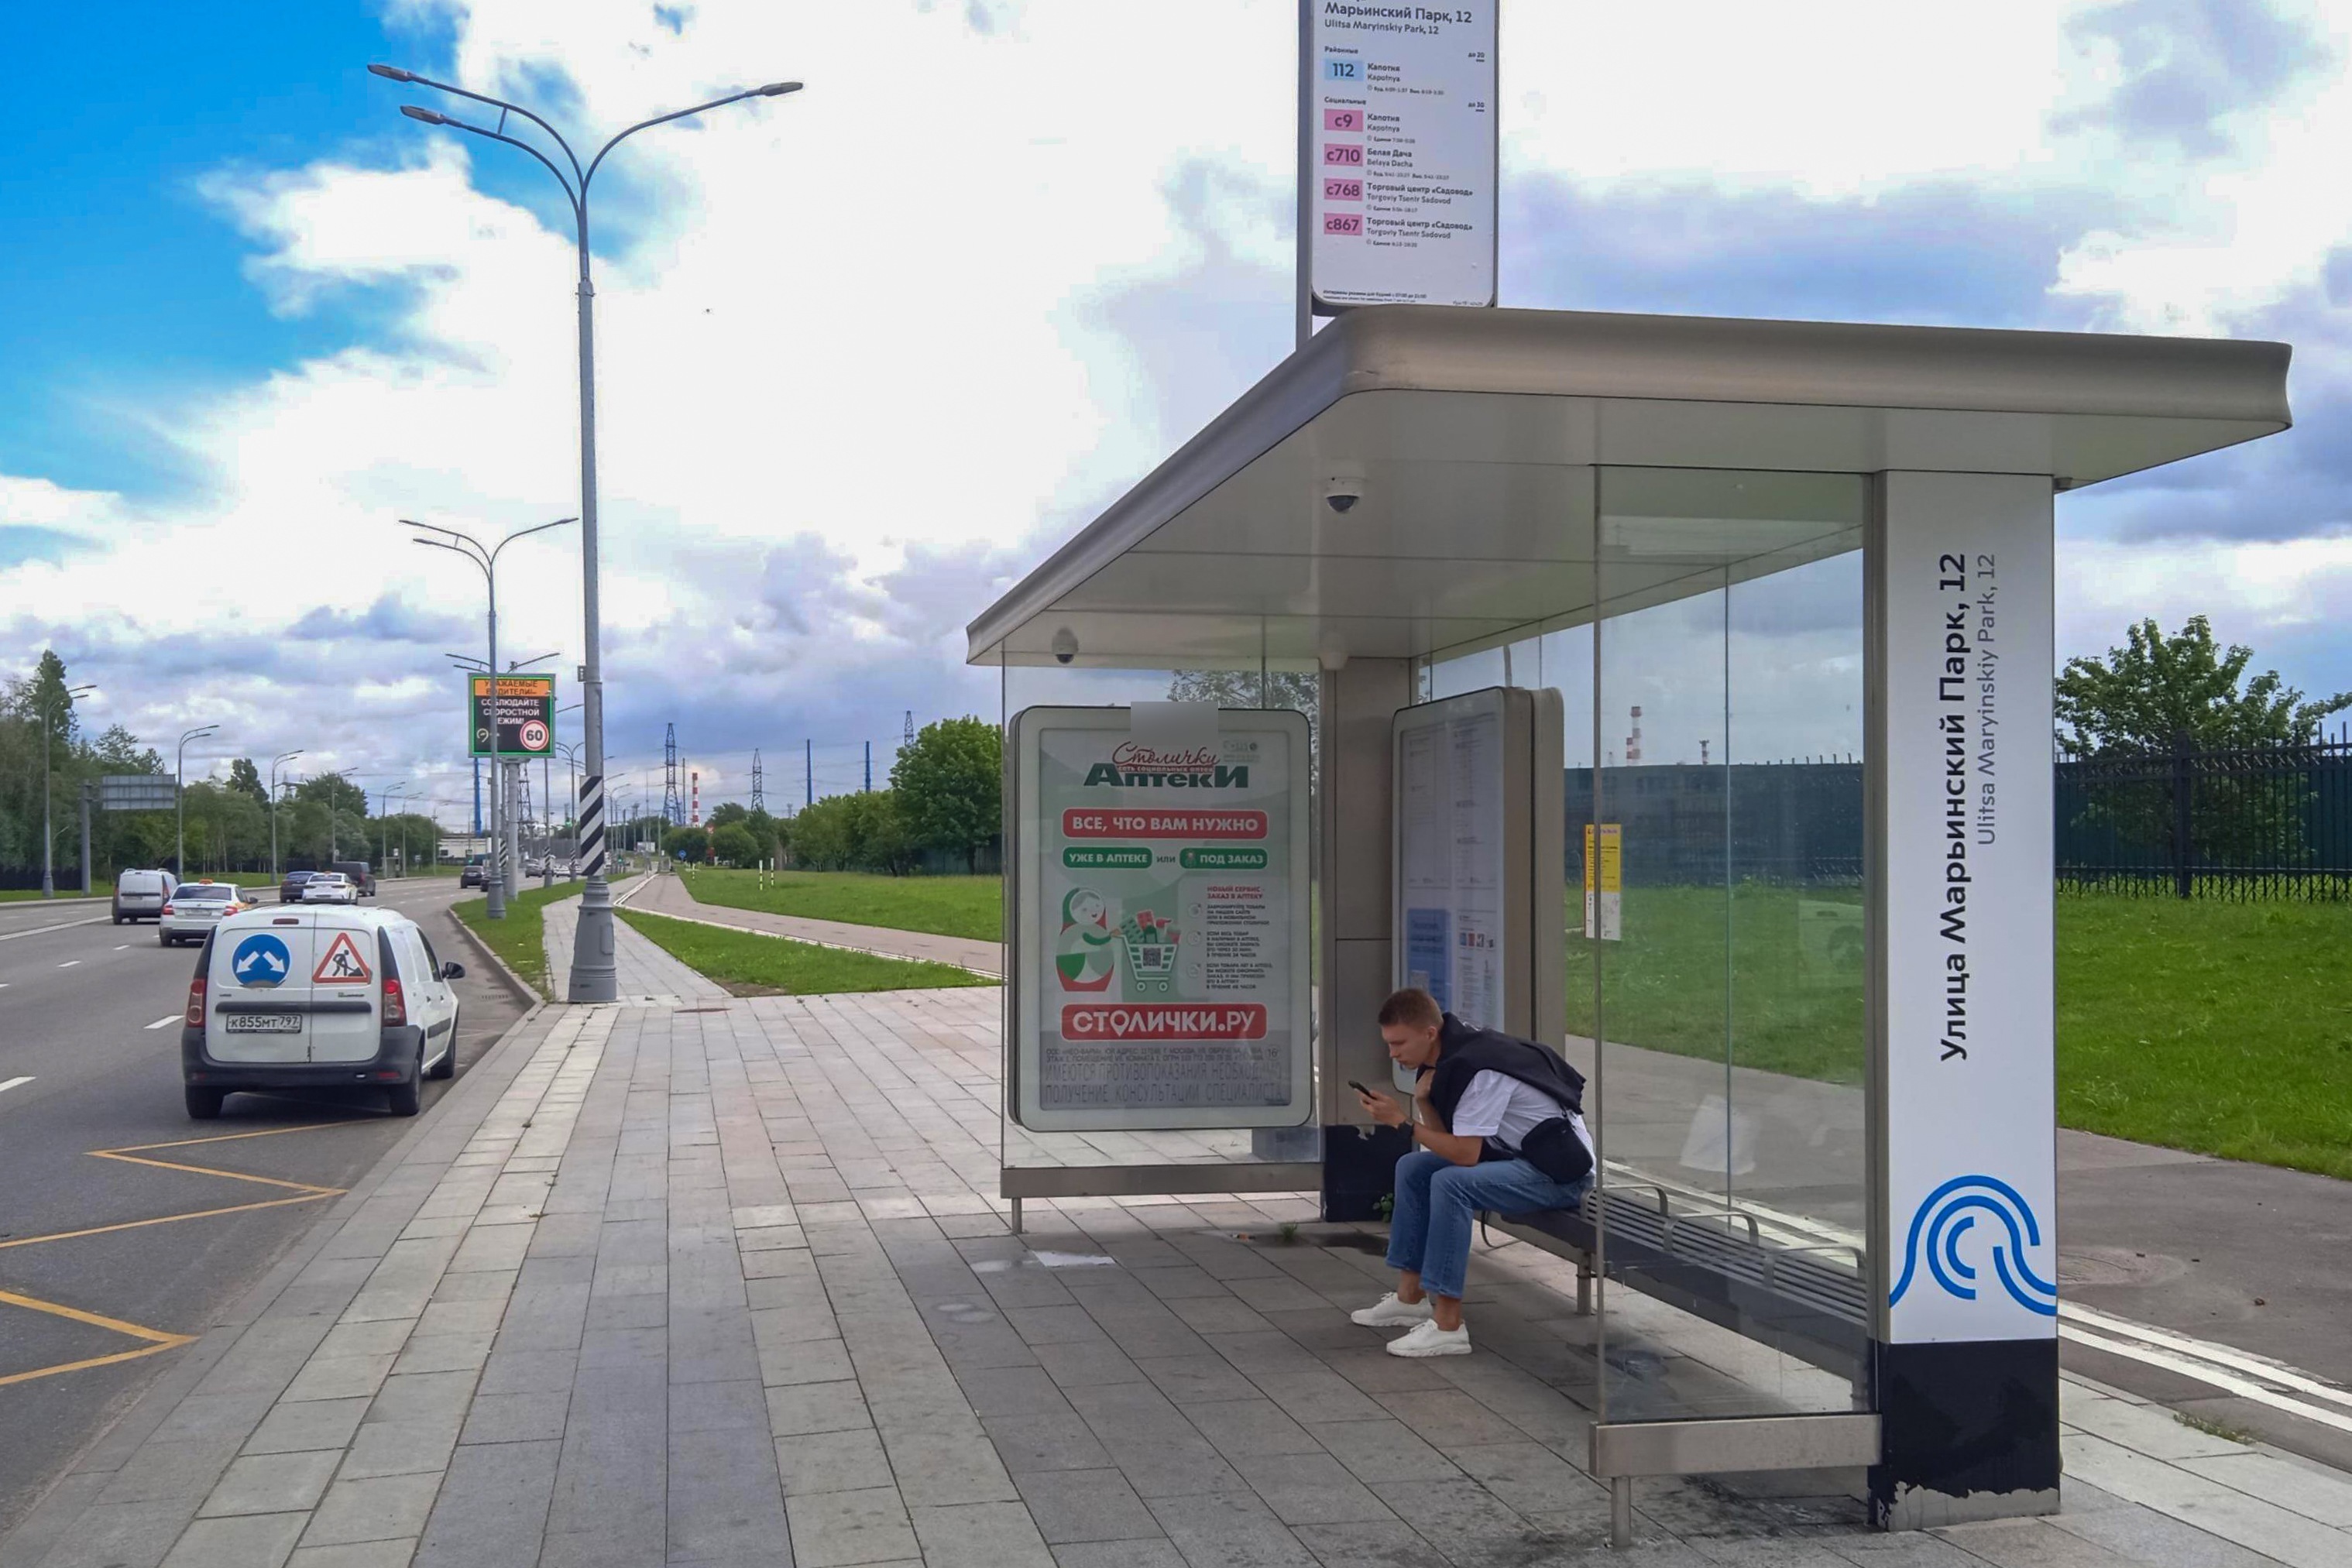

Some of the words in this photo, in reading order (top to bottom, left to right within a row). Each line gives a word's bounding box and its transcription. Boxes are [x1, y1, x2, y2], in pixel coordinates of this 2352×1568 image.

[1324, 2, 1412, 19] Марьинский
[1415, 8, 1453, 24] Парк,
[1455, 11, 1472, 23] 12
[1324, 19, 1351, 29] Ulitsa
[1353, 21, 1403, 33] Maryinskiy
[1404, 24, 1427, 35] Park,
[1428, 26, 1439, 35] 12
[1333, 63, 1355, 77] 112
[1367, 63, 1400, 72] Капотня
[1367, 74, 1400, 83] Kapotnya
[1367, 113, 1400, 122] Капотня
[1367, 124, 1400, 132] Kapotnya
[1367, 148, 1391, 156] Белая
[1392, 149, 1413, 158] Дача
[1367, 159, 1390, 167] Belaya
[1367, 183, 1406, 192] Торговый
[1406, 186, 1430, 195] центр
[1431, 186, 1473, 196] «Садовод»
[1421, 196, 1451, 204] Sadovod
[1367, 218, 1405, 227] Торговый
[1406, 220, 1430, 228] центр
[1431, 221, 1473, 231] «Садовод»
[1421, 231, 1451, 239] Sadovod
[1939, 554, 1966, 592] 12
[1977, 554, 1995, 578] 12
[1976, 586, 1998, 642] Park,
[1939, 603, 1971, 701] Парк,
[1976, 649, 1999, 777] Maryinskiy
[526, 729, 544, 742] 60
[1111, 741, 1221, 765] Столички
[1976, 783, 1996, 845] Ulitsa
[1072, 816, 1107, 832] ВСЕ,
[1112, 817, 1146, 831] ЧТО
[1150, 817, 1188, 831] ВАМ
[1193, 818, 1258, 832] НУЖНО
[1939, 715, 1972, 944] Марьинский
[1069, 853, 1095, 863] УЖЕ
[1097, 854, 1104, 863] В
[1106, 853, 1149, 863] АПТЕКЕ
[1200, 854, 1225, 865] ПОД
[1228, 855, 1263, 864] ЗАКАЗ
[1941, 953, 1970, 1062] Улица
[232, 1017, 278, 1028] К855МТ
[280, 1017, 297, 1025] 797
[1073, 1010, 1256, 1037] СТОЛИЧКИ.РУ
[1046, 1084, 1108, 1103] ПОЛУЧЕНИЕ
